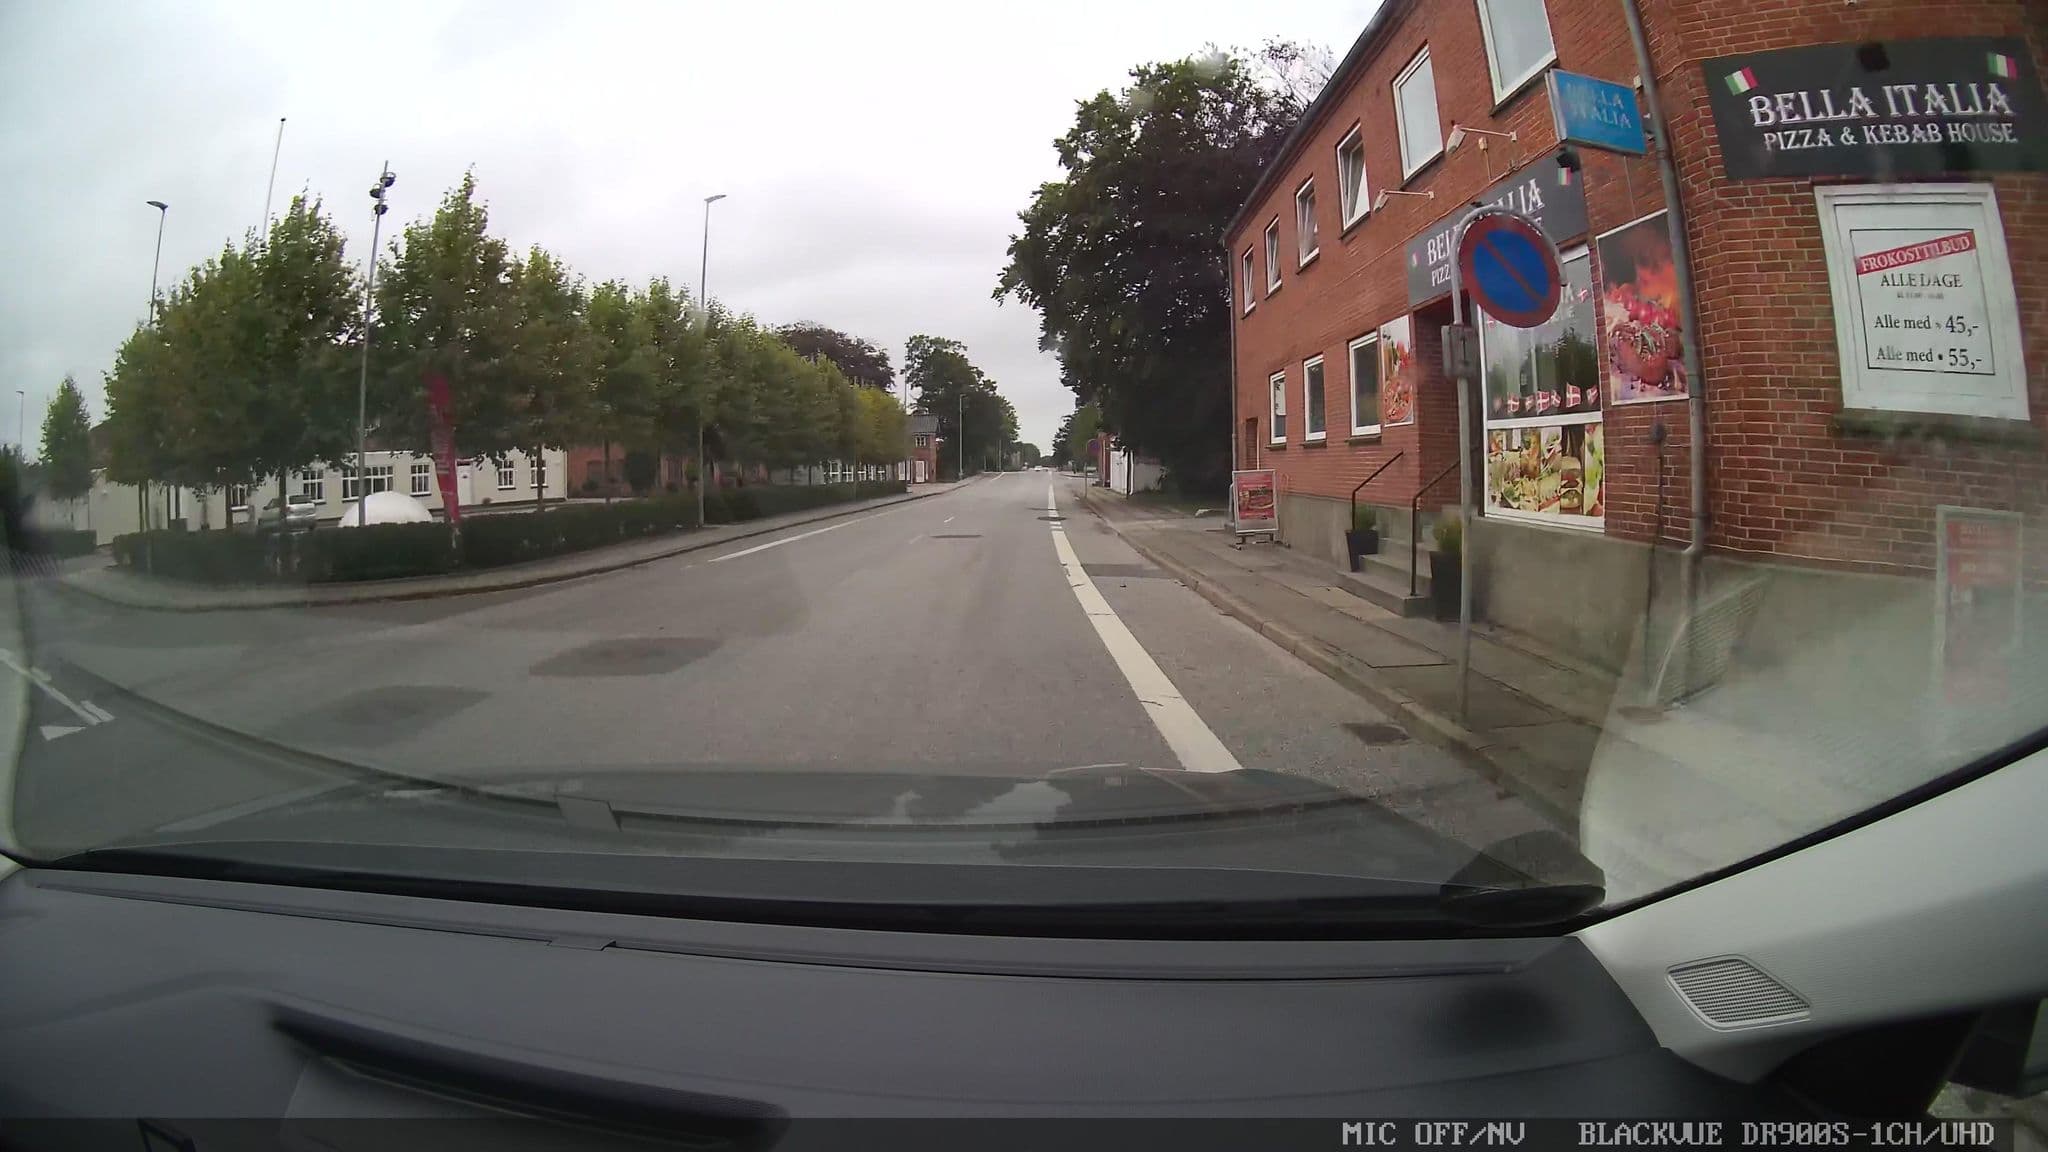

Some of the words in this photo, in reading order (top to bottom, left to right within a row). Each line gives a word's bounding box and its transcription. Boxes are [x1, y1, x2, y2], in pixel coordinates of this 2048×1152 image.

[1748, 87, 1880, 127] BELLA
[1882, 82, 2017, 117] ITALIA
[1764, 128, 1834, 151] PIZZA
[1840, 126, 1858, 145] &
[1862, 123, 1943, 145] KEBAB
[1947, 122, 2018, 144] HOUSE
[1861, 236, 1970, 271] FROKOSTTILBUD
[1431, 261, 1452, 287] PIZZ
[1880, 273, 1917, 287] ALLE
[1921, 273, 1963, 288] DAGE
[1874, 314, 1900, 329] Alle
[1904, 315, 1931, 329] med
[1945, 315, 1979, 337] 45,-
[1876, 346, 1903, 361] Alle
[1906, 348, 1934, 362] med
[1949, 348, 1983, 369] 55,-
